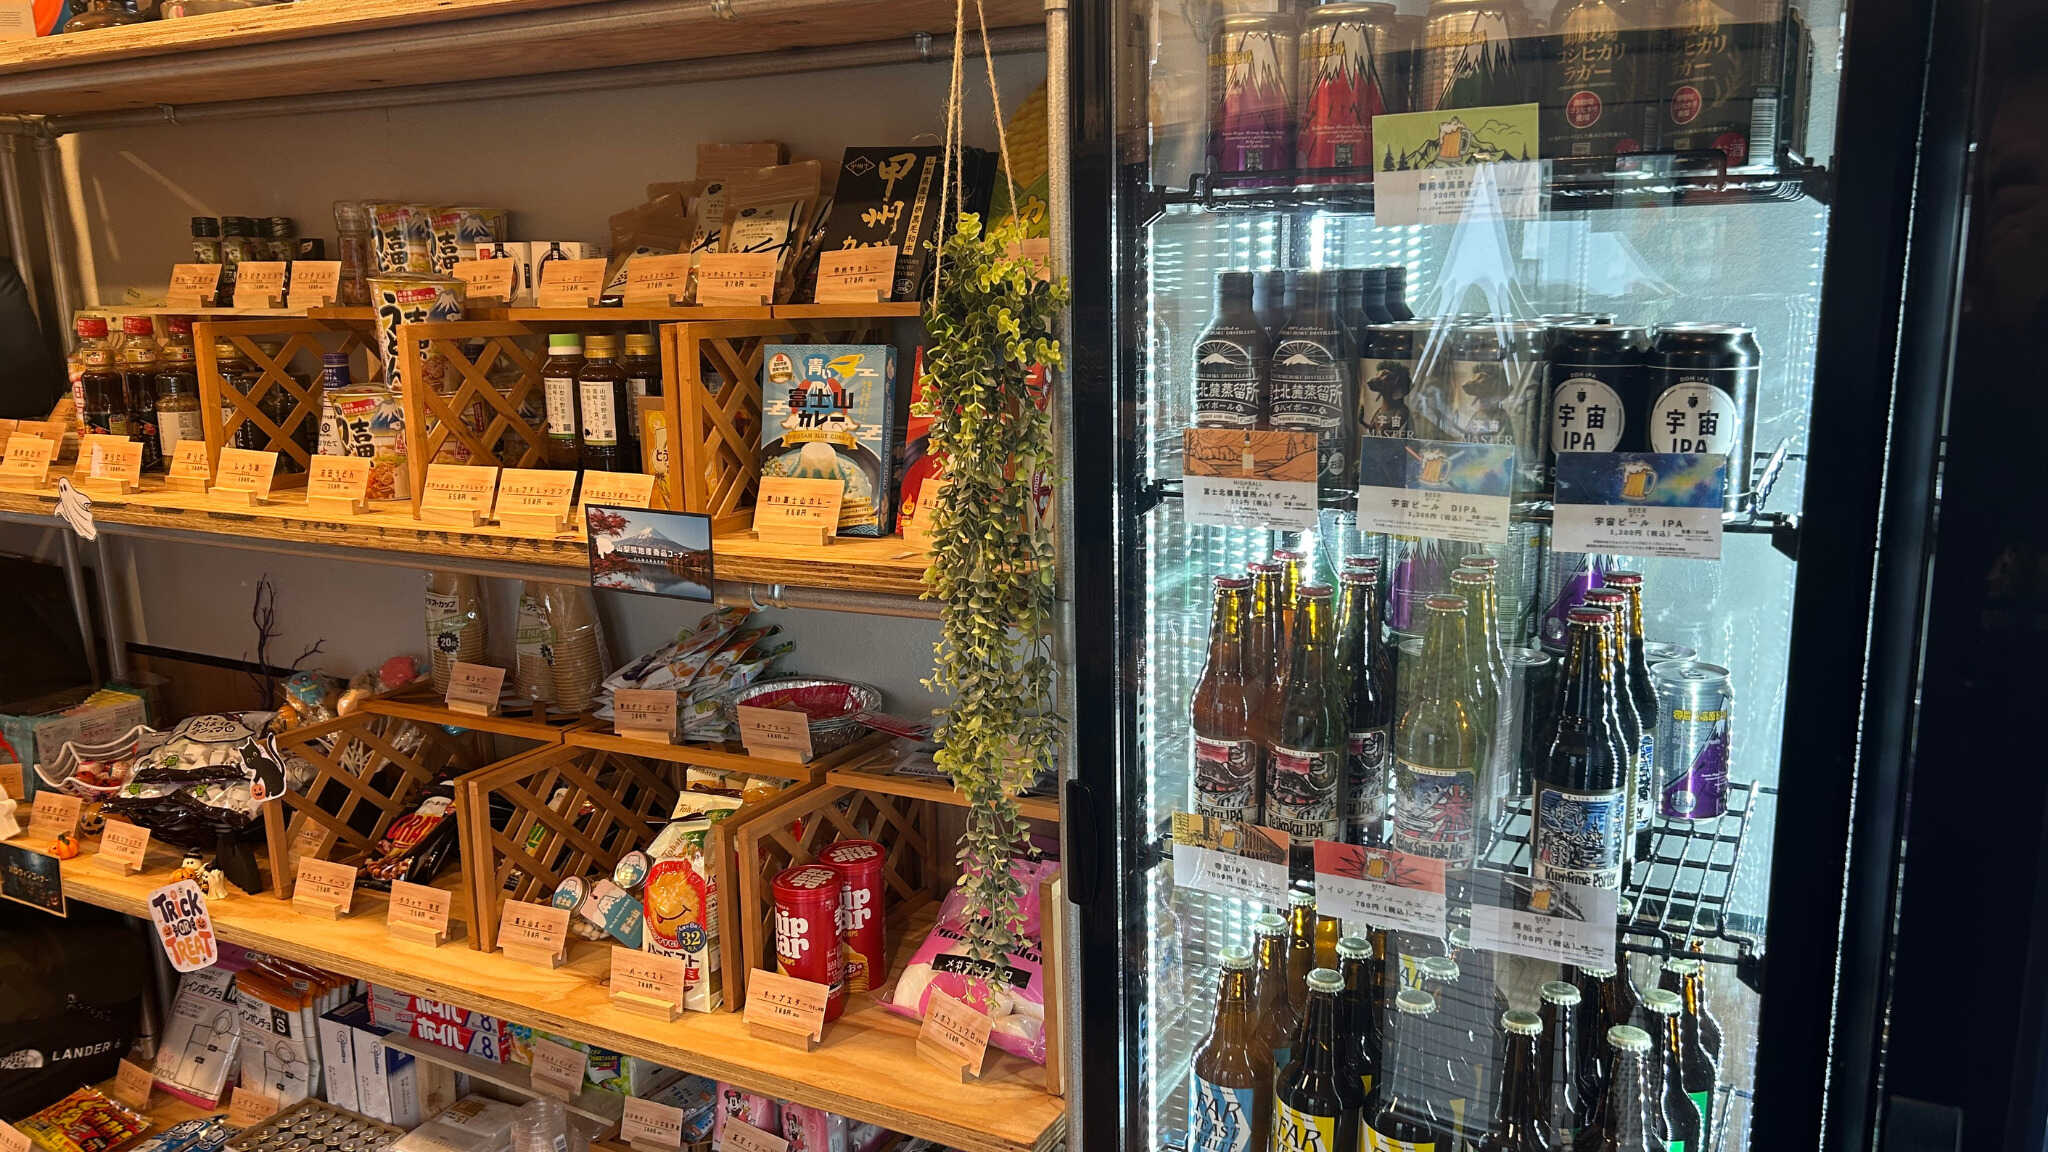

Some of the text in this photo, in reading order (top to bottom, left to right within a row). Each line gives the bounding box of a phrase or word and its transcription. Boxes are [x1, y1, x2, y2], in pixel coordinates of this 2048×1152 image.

[808, 358, 832, 379] 青い
[788, 388, 854, 409] 富士山
[798, 410, 846, 429] カレー
[1559, 404, 1607, 429] 宇宙
[1666, 410, 1719, 436] 宇宙
[1563, 432, 1596, 450] IPA
[1671, 438, 1708, 453] IPA
[1451, 504, 1478, 513] DIPA
[1594, 517, 1683, 528] 宇宙ビール IPA
[1228, 809, 1244, 821] IPA
[1306, 822, 1324, 837] IPA
[179, 921, 190, 934] OR
[682, 931, 701, 946] 32
[165, 930, 212, 966] TREAT
[276, 1018, 286, 1033] S
[52, 1041, 111, 1062] LANDER
[1196, 1091, 1240, 1124] FAR
[1278, 1115, 1322, 1152] FAR
